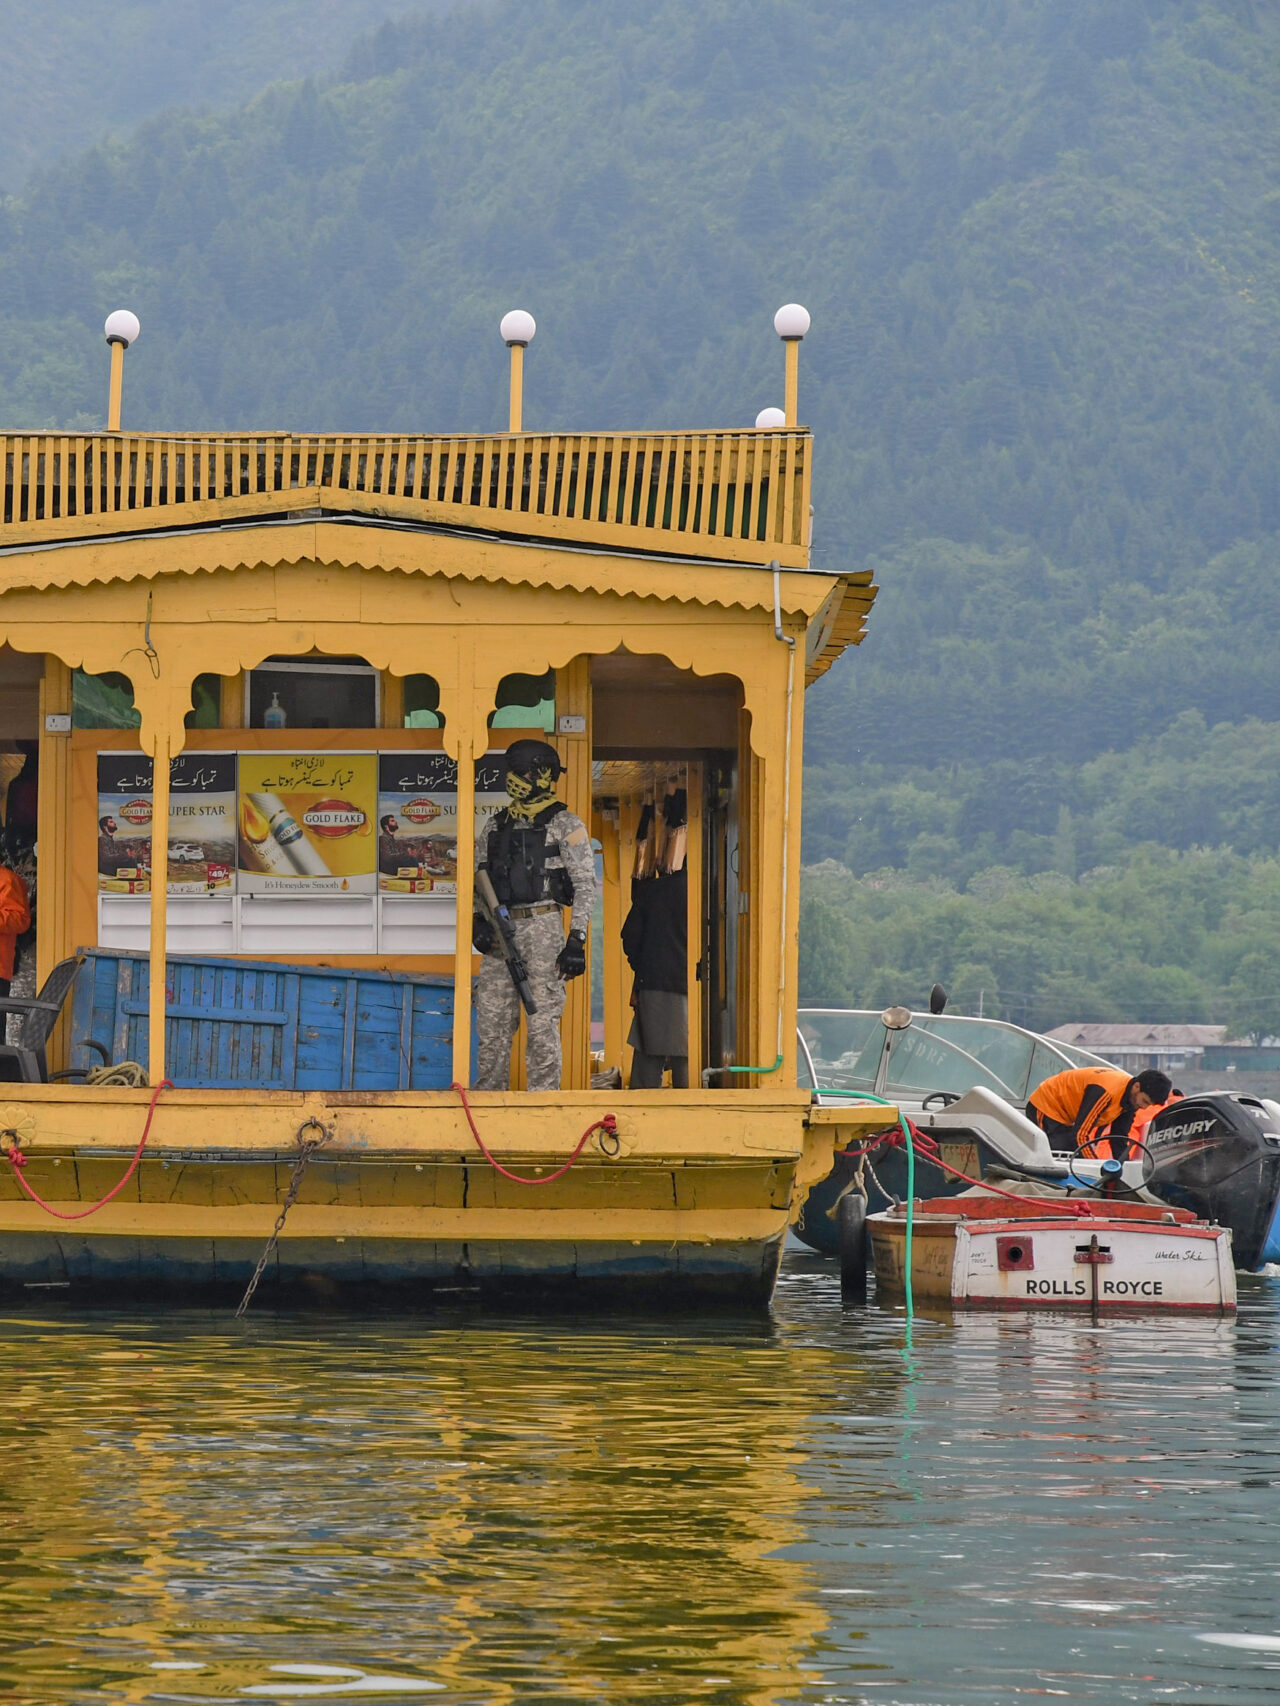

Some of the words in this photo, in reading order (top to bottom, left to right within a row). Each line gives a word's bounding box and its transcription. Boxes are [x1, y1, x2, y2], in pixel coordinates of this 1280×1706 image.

[261, 778, 277, 792] ہے
[168, 806, 196, 816] UPER
[199, 806, 226, 816] STAR
[305, 814, 331, 823] GOLD
[334, 814, 362, 823] FLAKE
[207, 882, 216, 890] 10
[275, 881, 310, 890] Honeydew
[312, 881, 339, 889] Smooth
[1146, 1118, 1218, 1147] MERCURY
[1026, 1280, 1086, 1296] ROLLS
[1103, 1281, 1163, 1296] ROYCE
